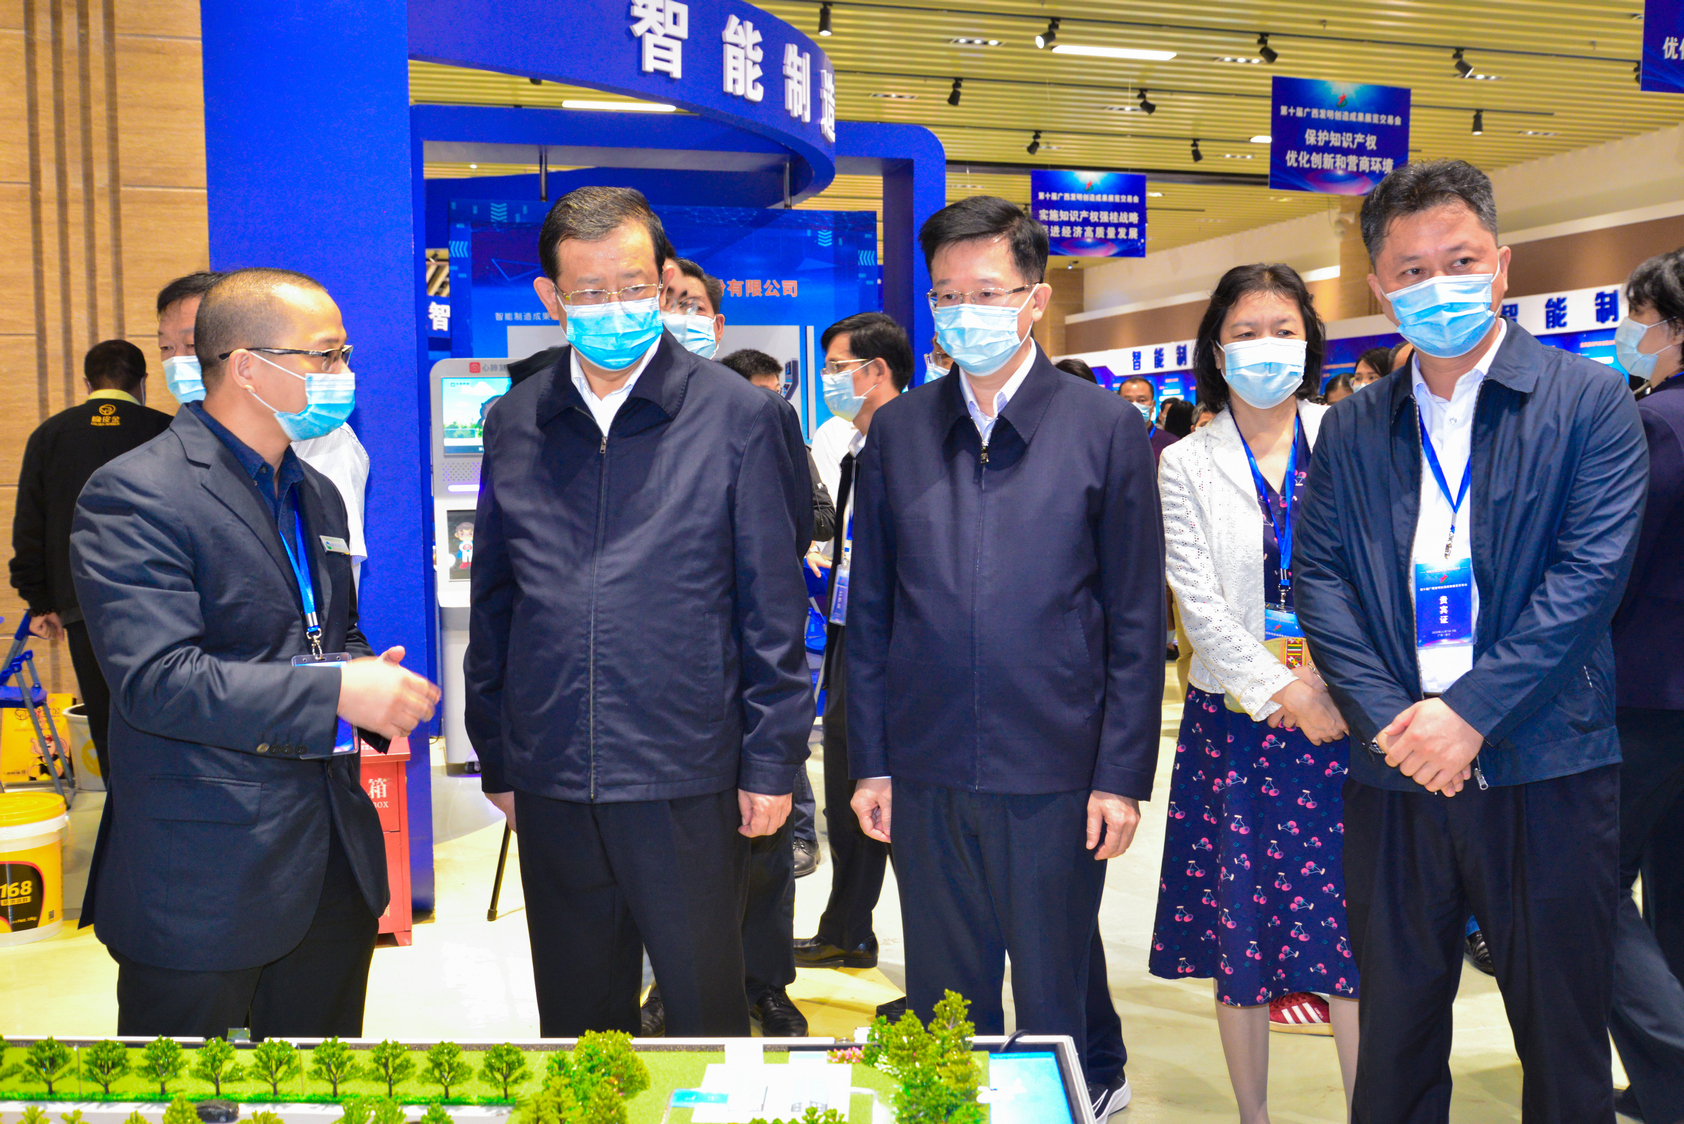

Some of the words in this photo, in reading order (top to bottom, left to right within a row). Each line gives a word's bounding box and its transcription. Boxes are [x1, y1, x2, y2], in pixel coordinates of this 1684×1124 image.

[630, 0, 836, 143] 智能制造
[1304, 128, 1377, 150] 保护知识产权
[1285, 150, 1394, 175] 优化创新和营商环境
[1038, 209, 1139, 224] 实施知识产权强桂战略
[428, 301, 450, 331] 智
[368, 777, 387, 799] 箱
[0, 880, 32, 898] 168
